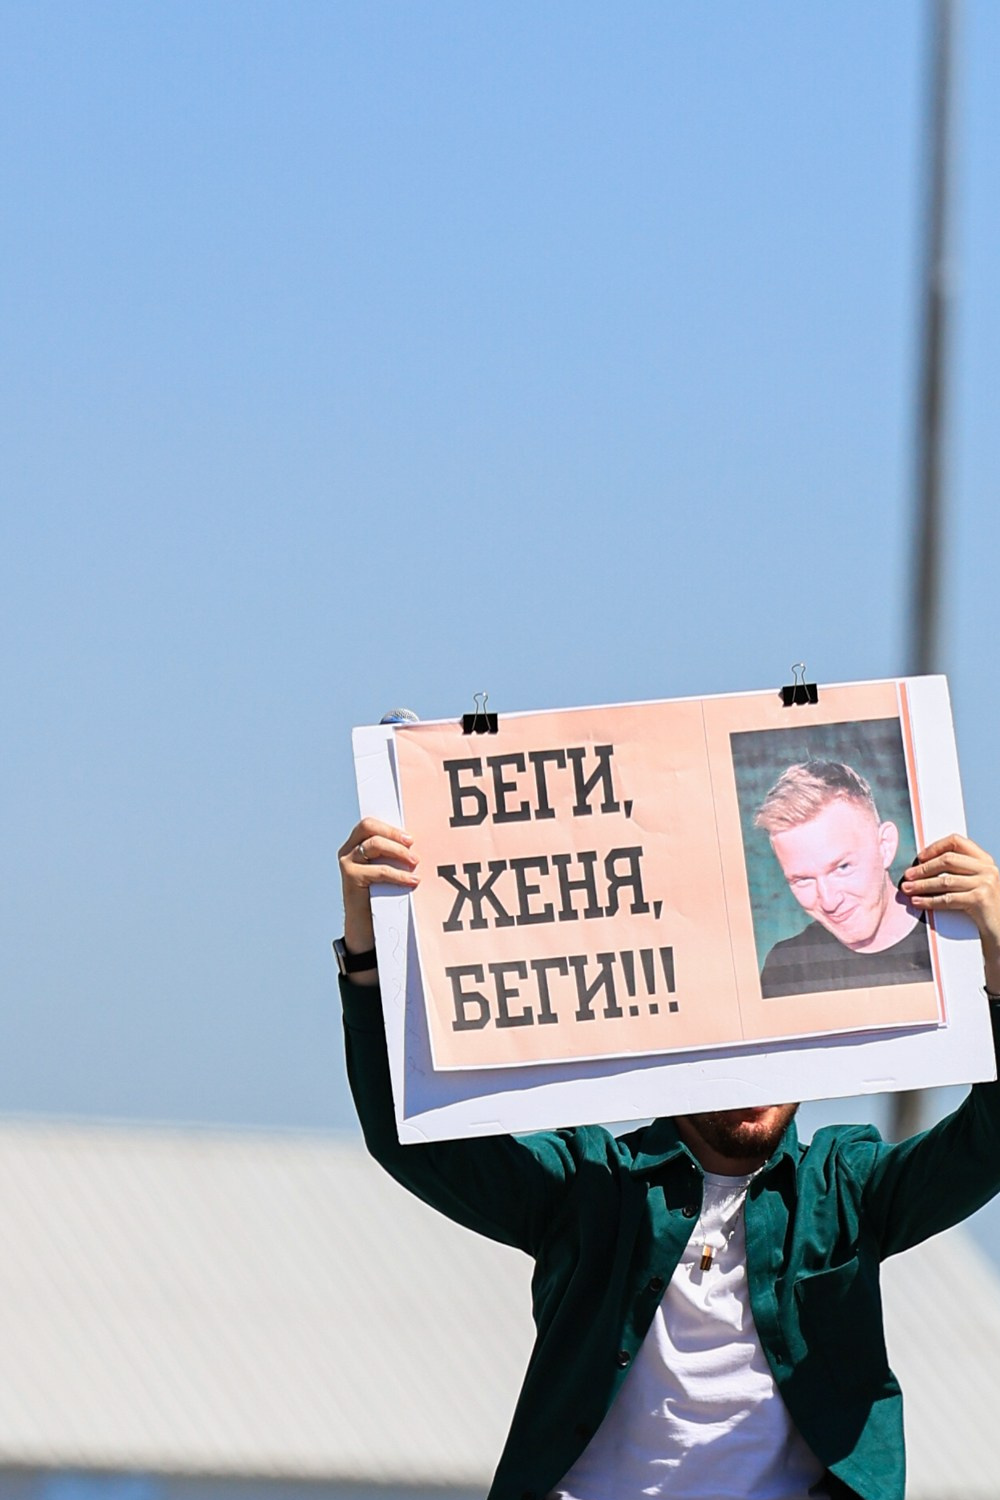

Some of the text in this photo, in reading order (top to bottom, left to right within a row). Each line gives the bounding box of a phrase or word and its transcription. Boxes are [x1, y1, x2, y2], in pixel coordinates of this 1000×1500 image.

[443, 744, 633, 826] БЕГИ,
[437, 846, 663, 932] ЖЕНЯ,
[445, 946, 679, 1031] БЕГИ!!!
